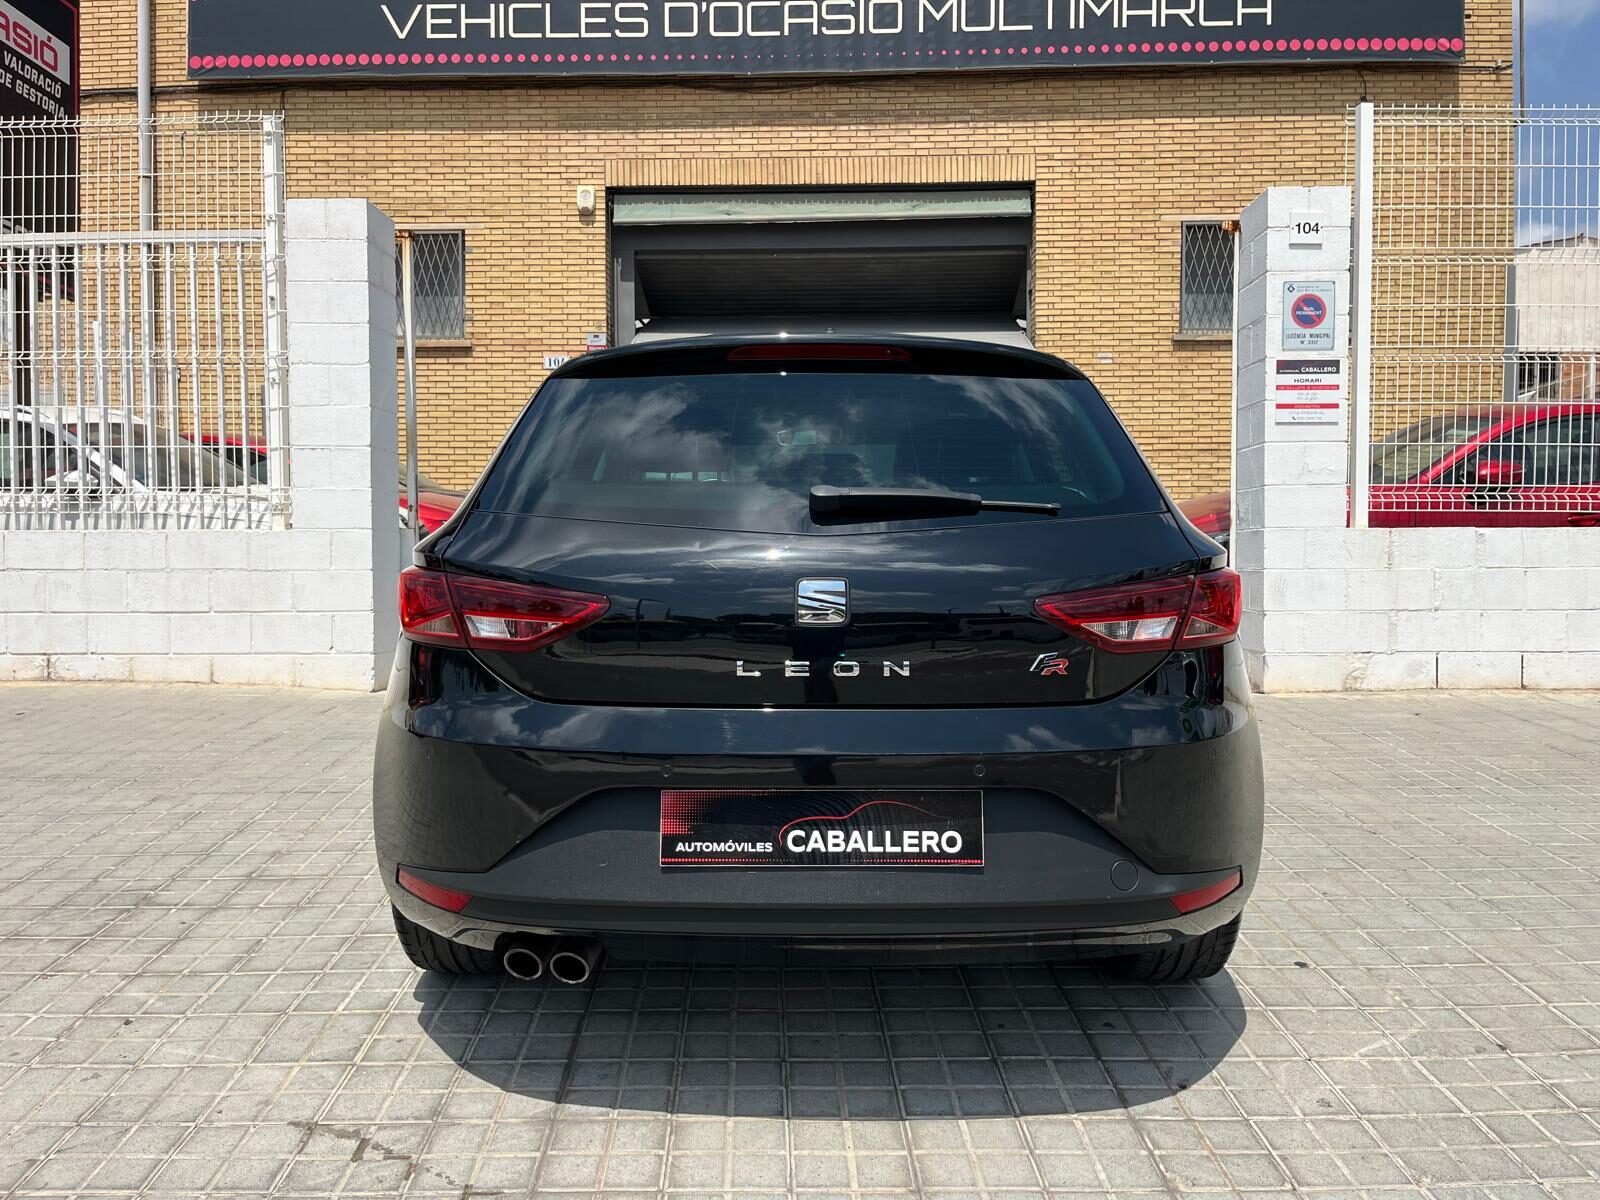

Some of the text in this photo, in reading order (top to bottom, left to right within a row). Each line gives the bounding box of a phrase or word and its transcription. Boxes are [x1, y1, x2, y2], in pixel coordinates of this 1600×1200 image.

[380, 1, 649, 40] VEHICLES
[918, 0, 1272, 33] MULTIMARCA
[3, 50, 62, 99] VALORACIÓ
[15, 79, 65, 121] GESTORIA
[1295, 221, 1320, 235] 104
[736, 660, 910, 677] LEON
[1029, 652, 1069, 676] FR
[675, 829, 963, 854] AUTOMÓVILES CABALLERO
